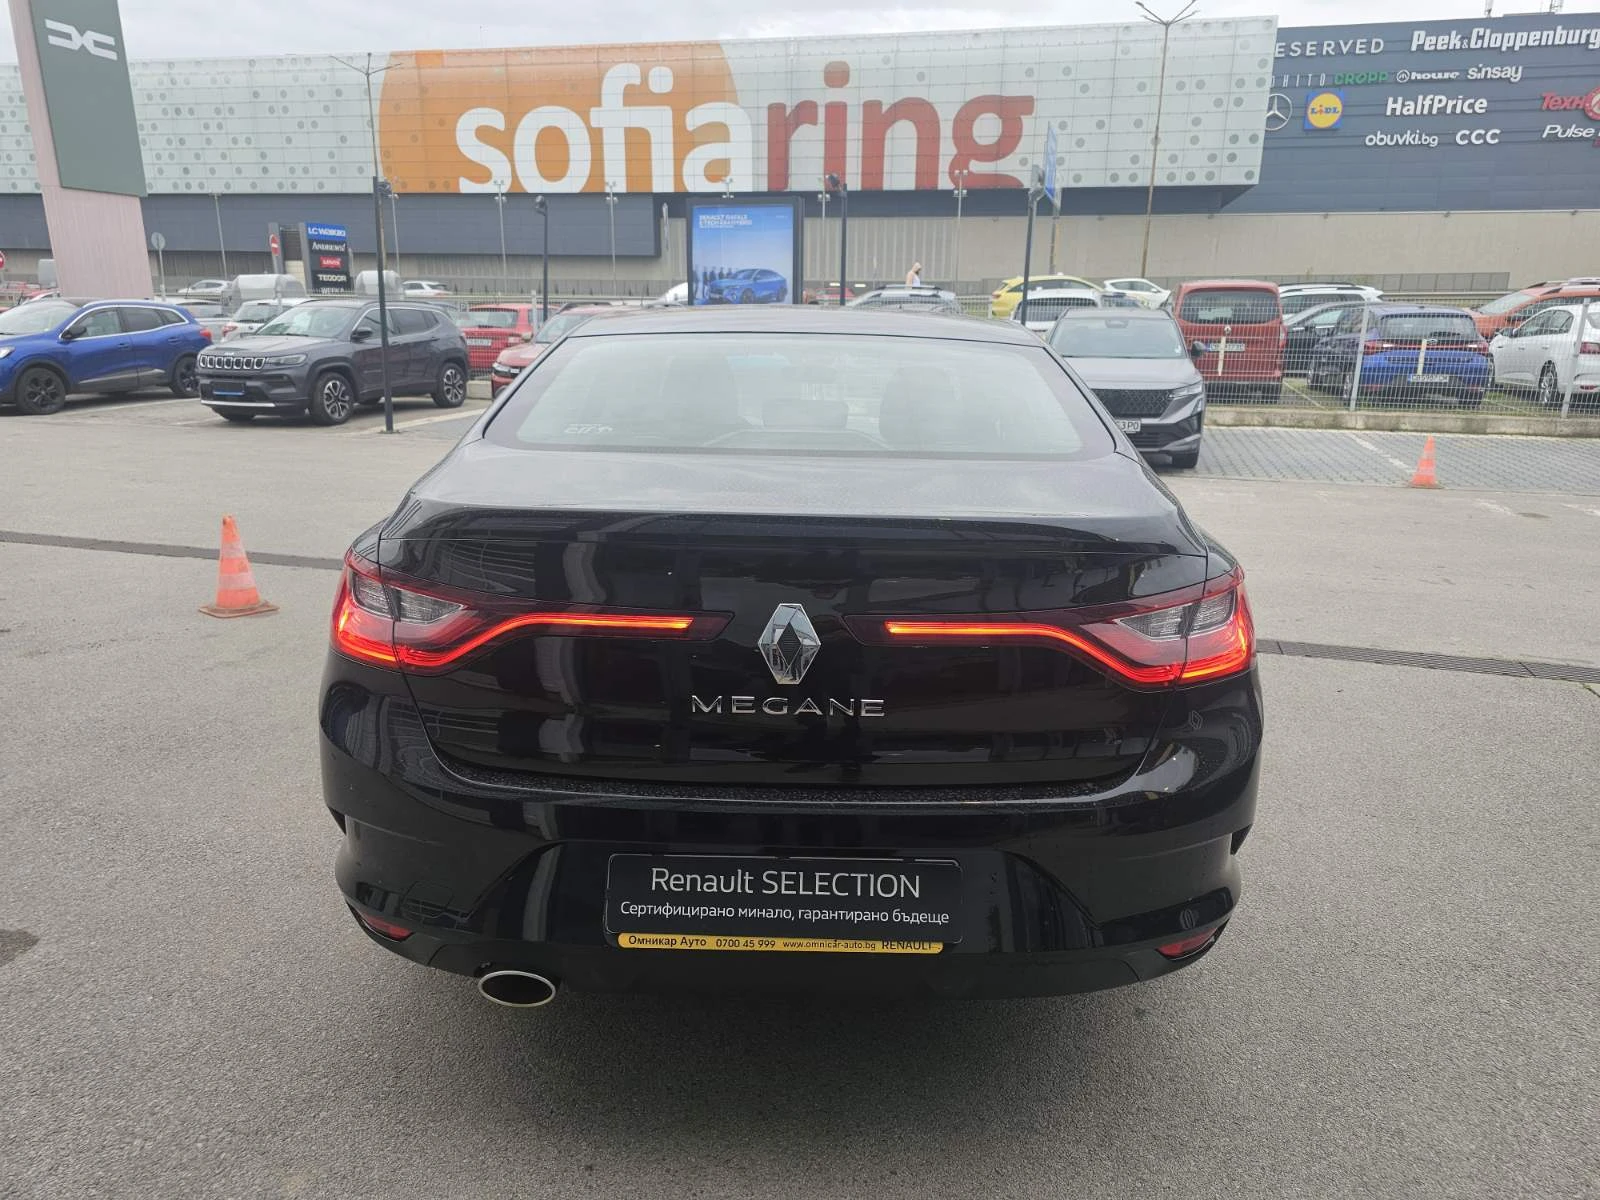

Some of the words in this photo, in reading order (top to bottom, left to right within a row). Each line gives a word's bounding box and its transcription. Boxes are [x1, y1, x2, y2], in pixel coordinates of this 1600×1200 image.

[1274, 38, 1385, 58] ESERVED
[1467, 64, 1522, 82] sinsay
[1386, 95, 1488, 116] HalfPrice
[1365, 130, 1438, 147] obuvki.bg
[1455, 129, 1501, 145] CCC
[1542, 124, 1595, 138] Pulse
[691, 695, 885, 717] MEGANE
[651, 867, 754, 894] Renault
[762, 870, 920, 898] SELECTION
[620, 901, 735, 919] Сертифицирано
[738, 906, 795, 921] минало,
[798, 908, 889, 923] гарантирано
[892, 908, 950, 925] бъдеще
[628, 935, 677, 947] Омникар
[680, 936, 707, 947] Ауто
[716, 938, 740, 948] 0700
[743, 939, 755, 948] 45
[758, 939, 776, 948] 999
[783, 940, 876, 951] www.omnicar-auto.bg
